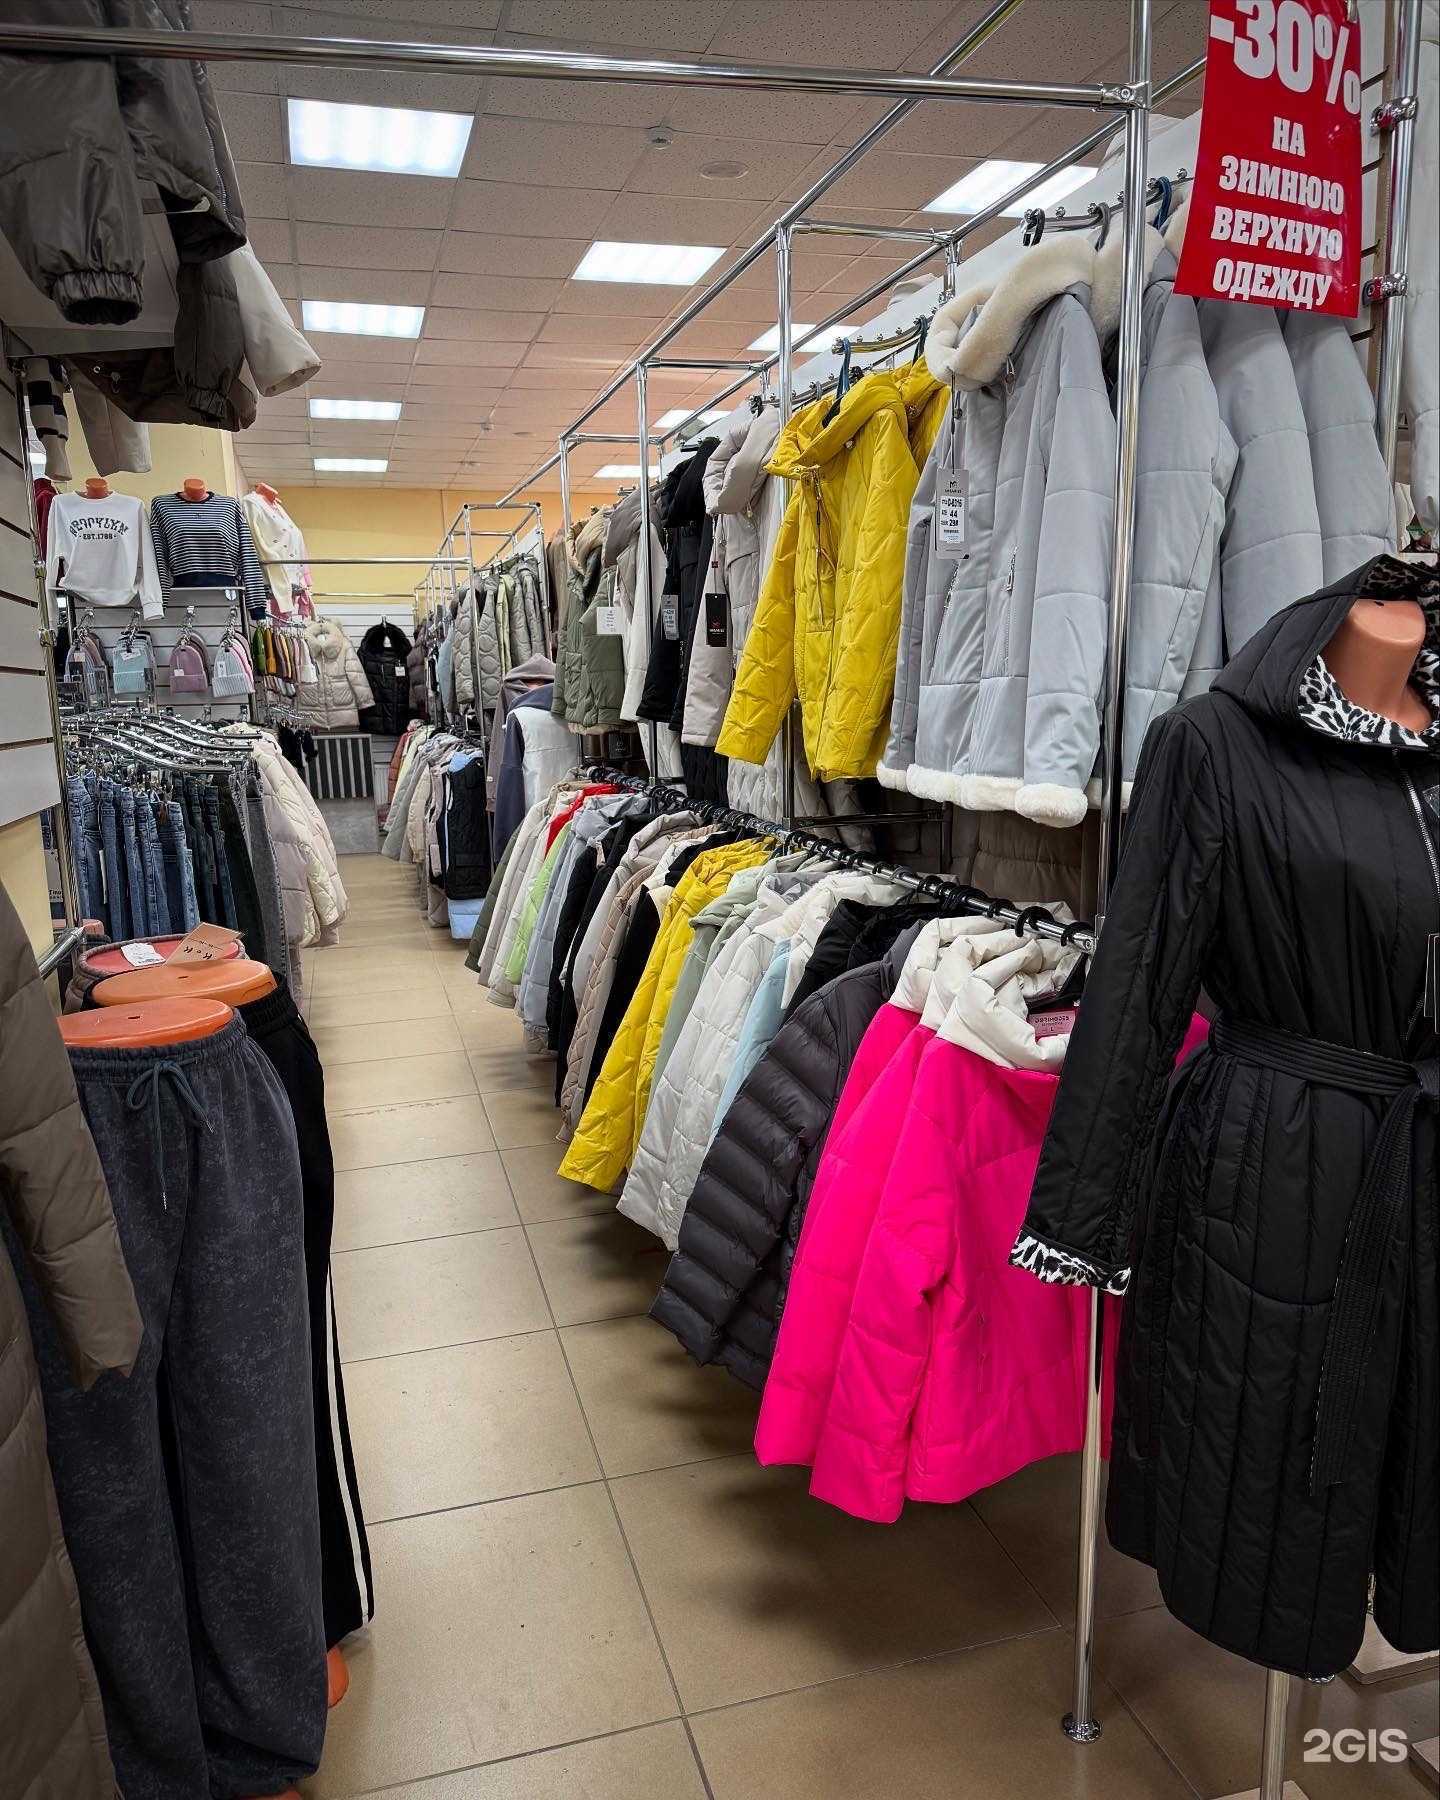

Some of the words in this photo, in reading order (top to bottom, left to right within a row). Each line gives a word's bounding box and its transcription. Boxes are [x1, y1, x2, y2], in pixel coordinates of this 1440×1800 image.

[1209, 0, 1361, 115] -30%
[1272, 116, 1306, 158] НА
[1219, 155, 1345, 215] ЗИМНЮЮ
[1210, 205, 1343, 262] ВЕРХНУЮ
[1212, 257, 1333, 310] ОДЕЖДУ
